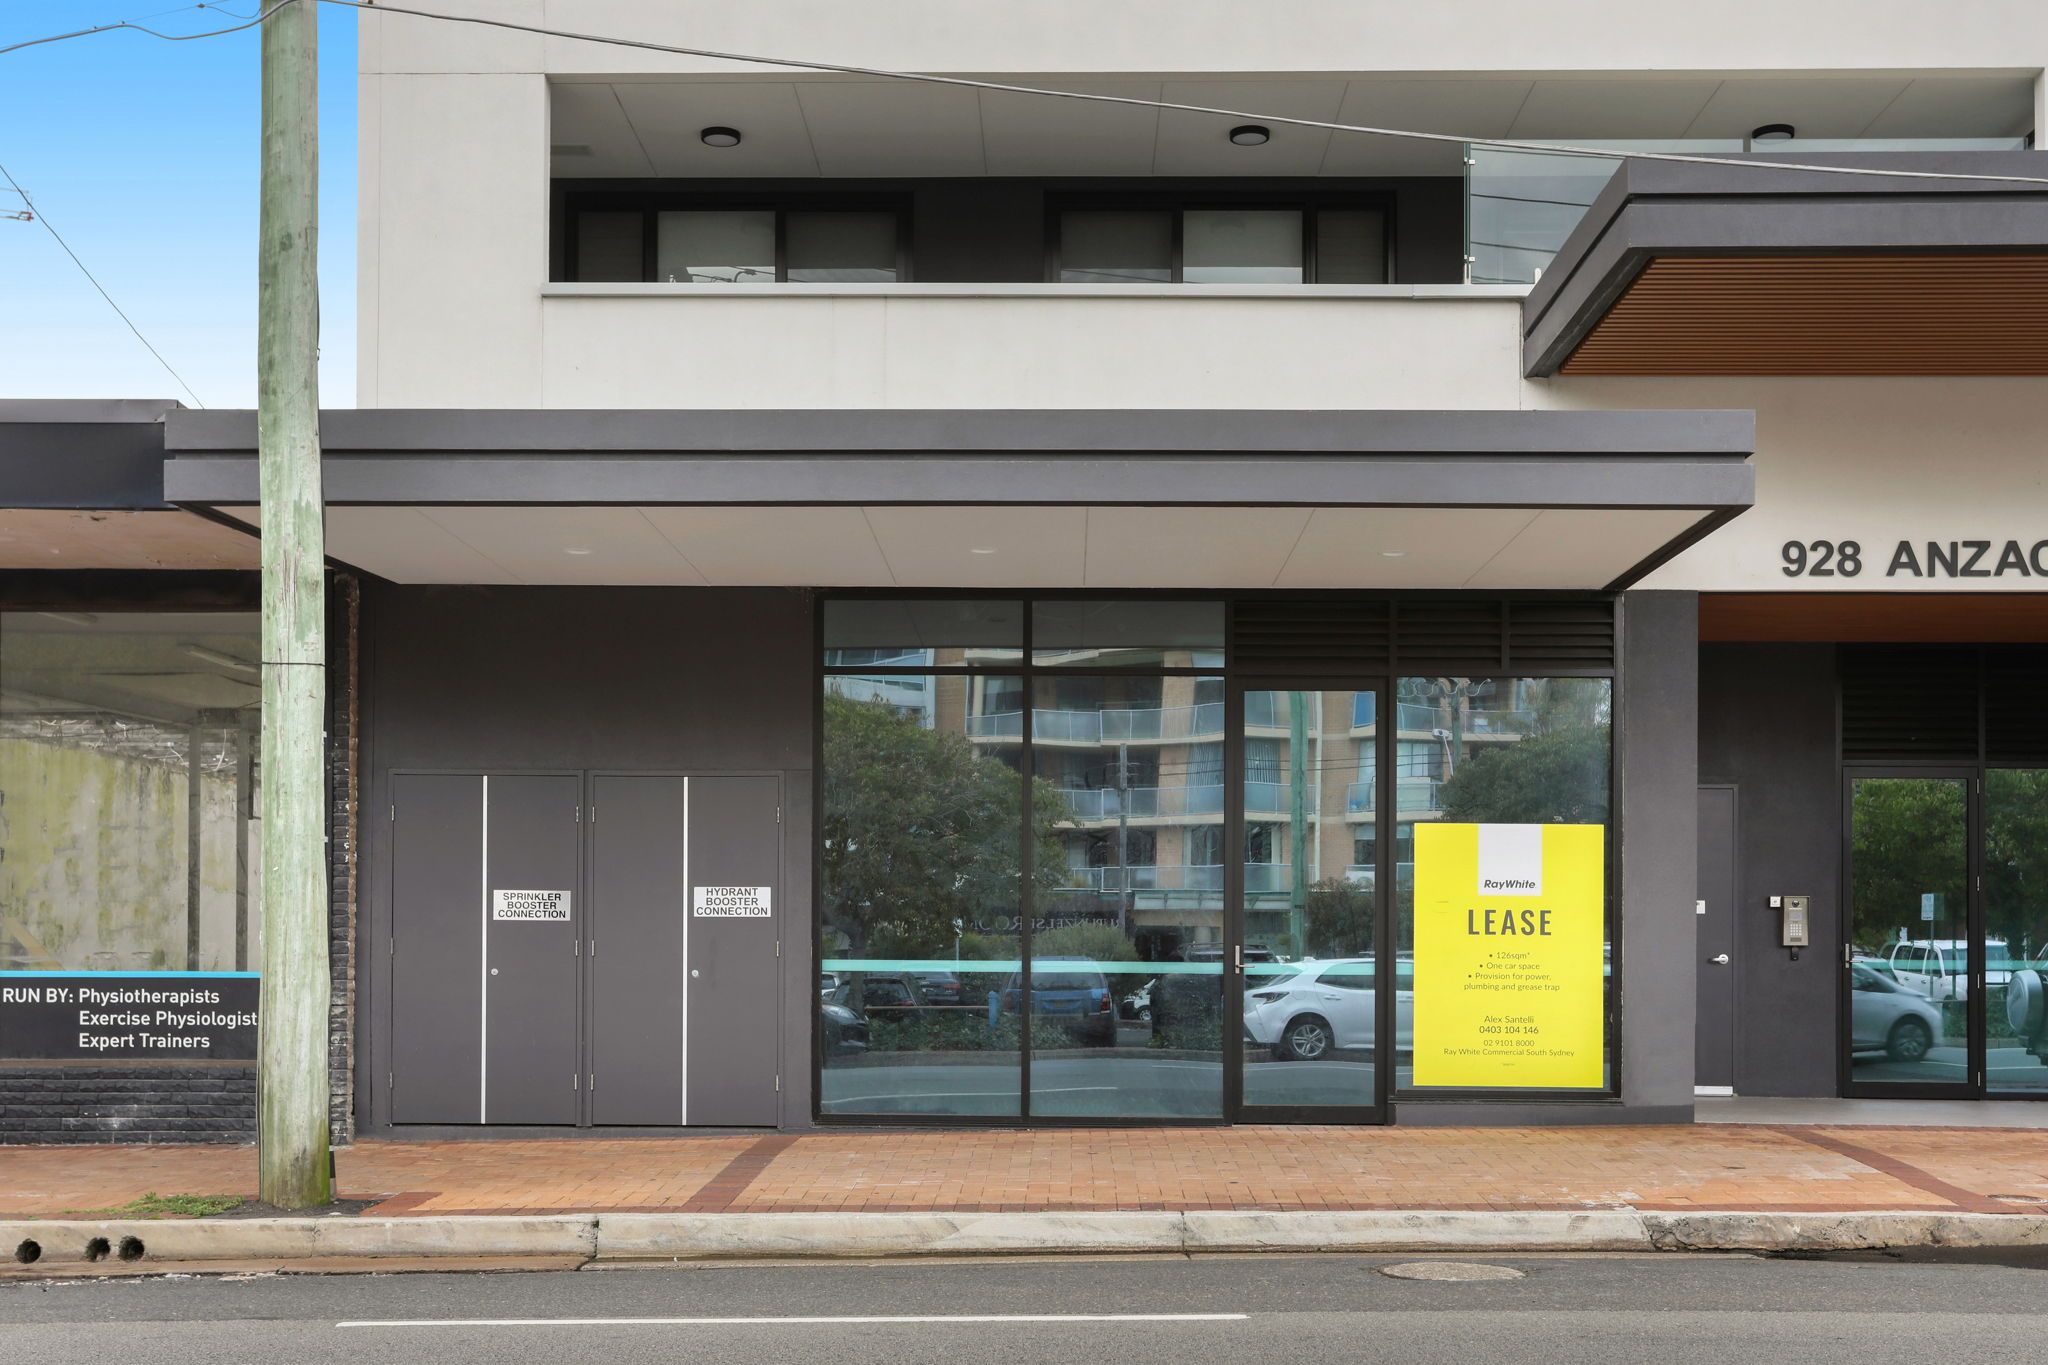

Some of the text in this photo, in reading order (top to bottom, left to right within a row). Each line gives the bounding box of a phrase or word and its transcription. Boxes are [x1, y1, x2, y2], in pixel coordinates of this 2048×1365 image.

[1781, 540, 1862, 577] 928
[503, 892, 562, 902] SPRINKLER
[706, 887, 758, 897] HYDRANT
[507, 901, 557, 910] BOOSTER
[706, 897, 758, 906] BOOSTER
[498, 909, 566, 919] CONNECTION
[696, 906, 768, 916] CONNECTION
[1468, 909, 1552, 936] LEASE
[1486, 962, 1503, 970] One
[1475, 972, 1511, 981] Provision
[1512, 972, 1524, 980] for
[1464, 982, 1500, 991] plumbing
[1517, 984, 1542, 992] grease
[1544, 984, 1560, 992] trap
[2, 988, 220, 1005] RUN BY: Physiotherapists
[78, 1010, 259, 1029] Exercise Physiologist
[1484, 1016, 1535, 1024] Alex Santelli
[1478, 1026, 1539, 1035] 0403 104 146
[78, 1032, 211, 1051] Expert Trainers
[1483, 1040, 1535, 1048] 02 9101 8000
[1548, 1049, 1575, 1058] Sydney
